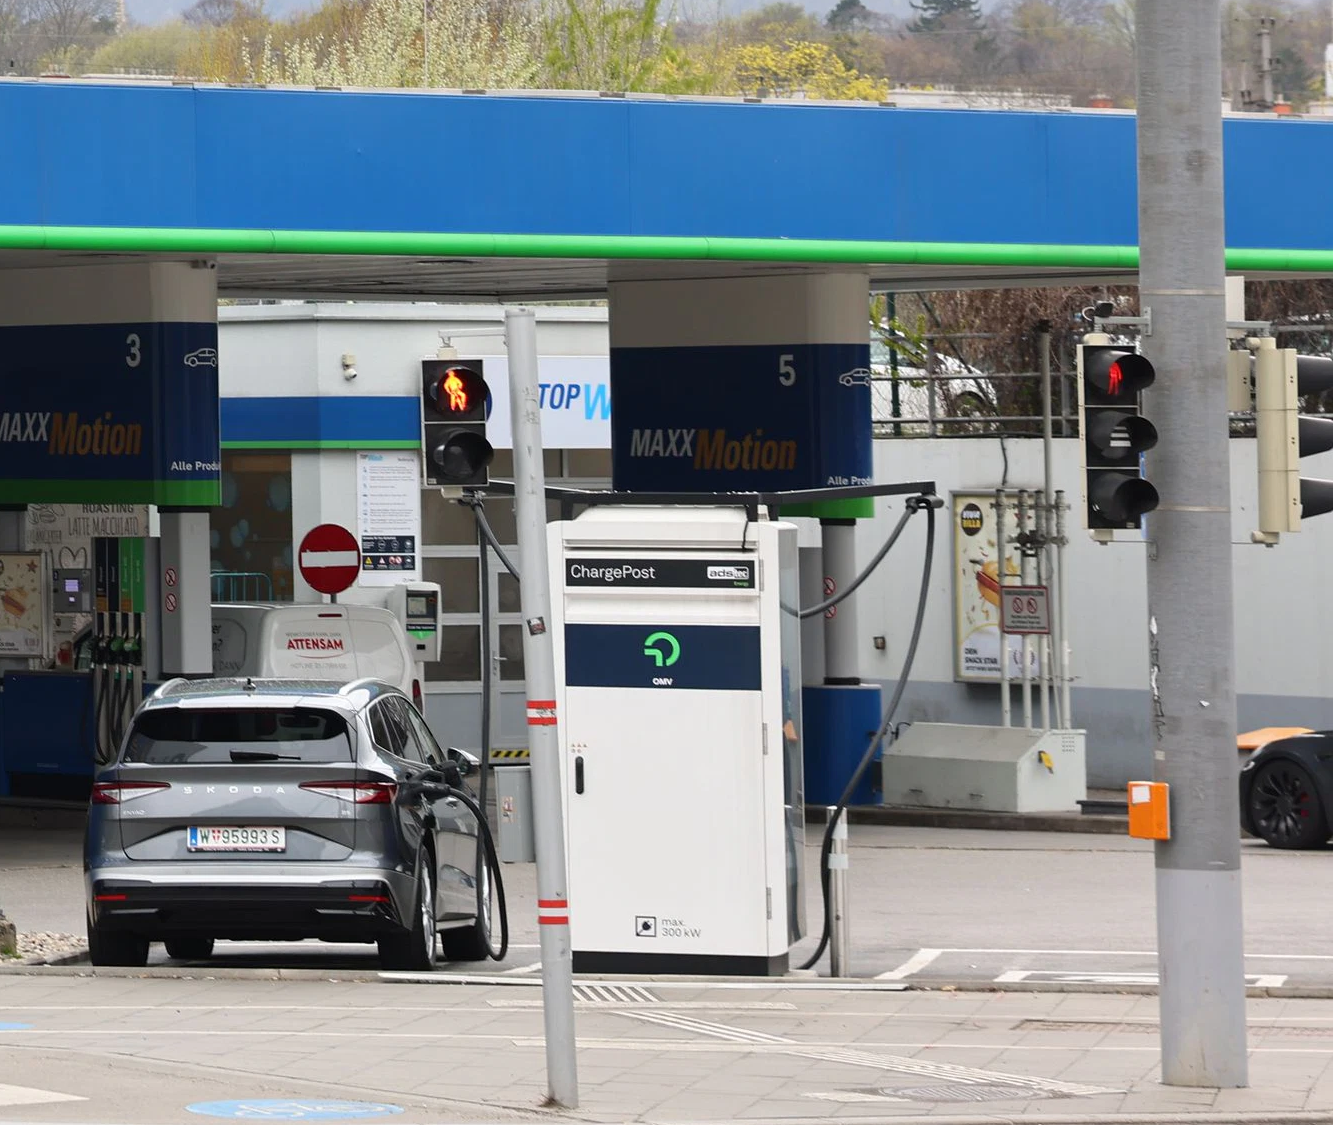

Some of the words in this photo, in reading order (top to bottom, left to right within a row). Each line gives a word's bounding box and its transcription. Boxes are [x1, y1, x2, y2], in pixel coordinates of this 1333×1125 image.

[125, 333, 141, 368] 3
[778, 354, 797, 387] 5
[170, 461, 193, 471] Alle
[827, 475, 849, 486] Alle
[570, 564, 656, 582] ChargePost
[287, 638, 344, 651] ATTENSAM
[652, 677, 673, 686] OMV
[199, 829, 210, 844] W
[661, 927, 683, 937] 300
[684, 927, 702, 938] kW
